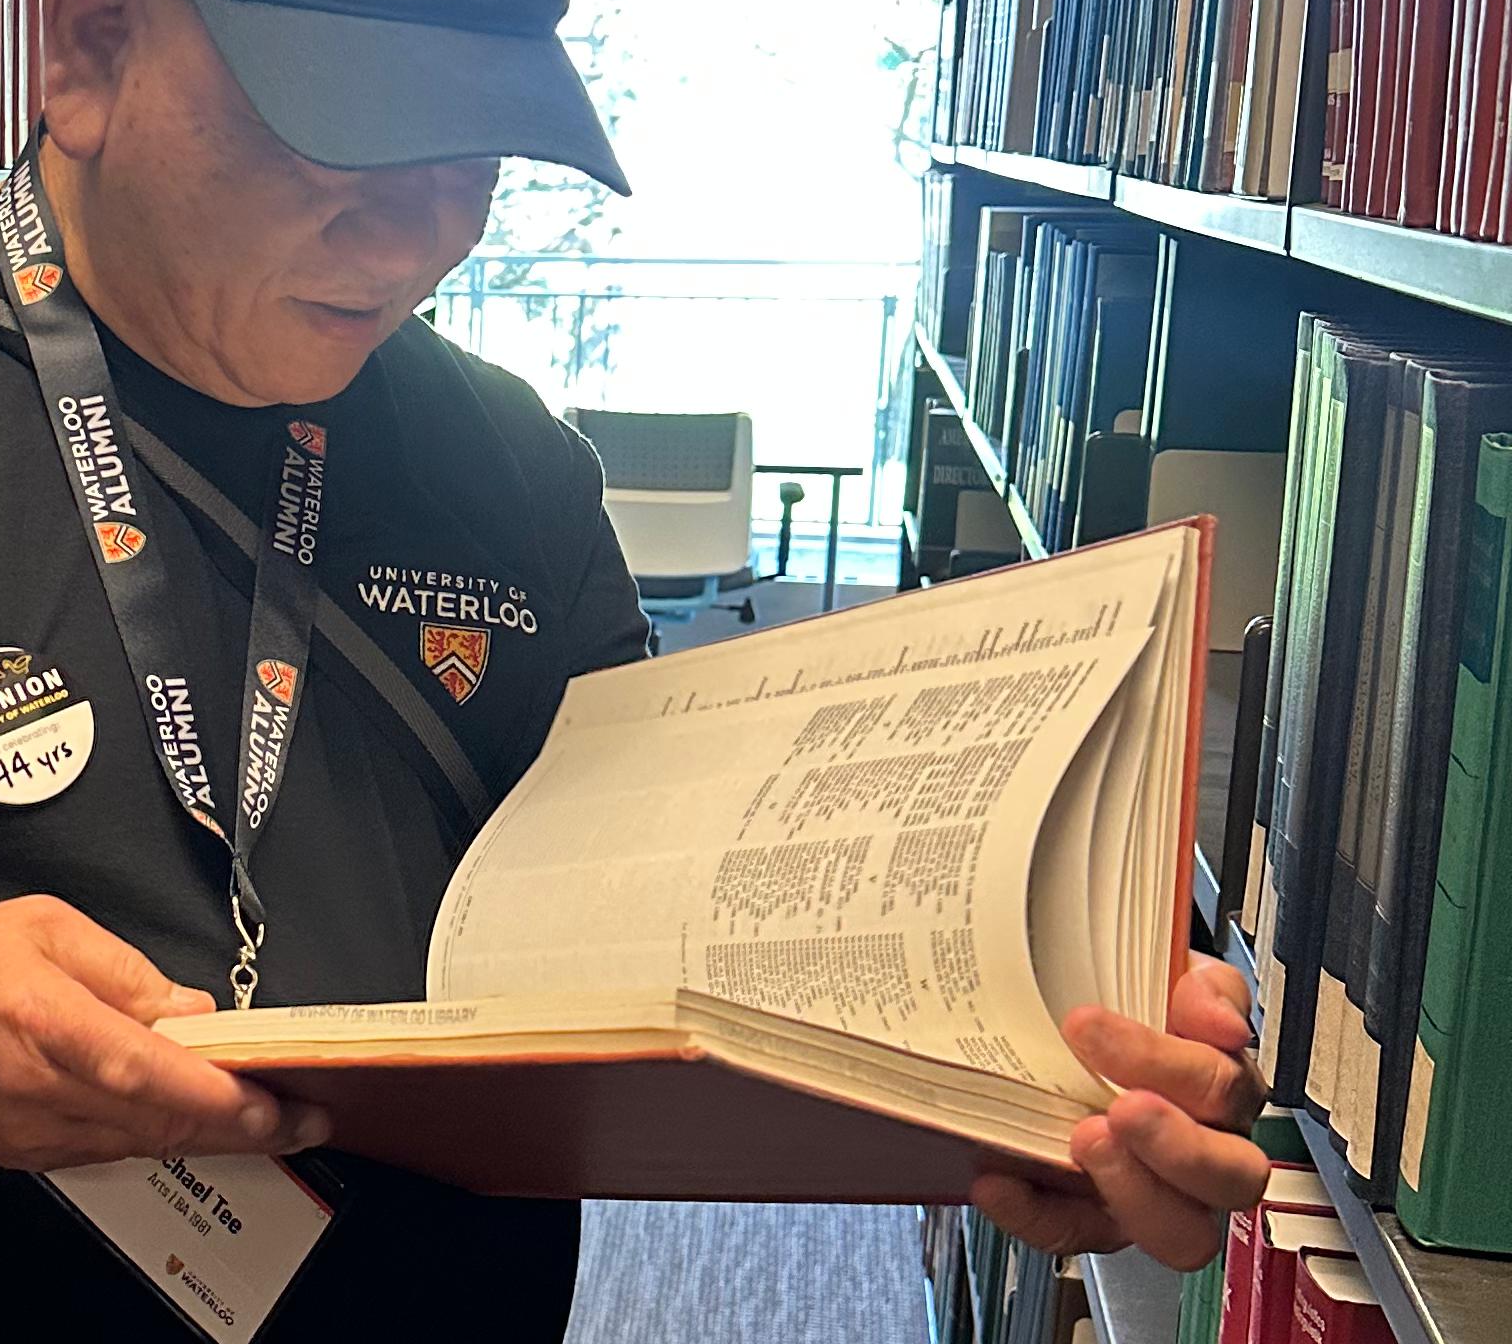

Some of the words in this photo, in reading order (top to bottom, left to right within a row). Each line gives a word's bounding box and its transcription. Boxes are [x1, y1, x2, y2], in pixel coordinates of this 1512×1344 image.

[14, 159, 53, 257] ALUMNI
[58, 396, 101, 522] WATERLOO
[79, 394, 138, 517] ALUMNI
[272, 446, 306, 556] ALUMNI
[296, 457, 325, 566] WATERLOO
[357, 582, 538, 635] WATERLOO
[369, 565, 501, 594] UNIVERSITY
[508, 586, 528, 604] OF
[5, 707, 20, 721] OF
[19, 689, 70, 715] WATERLOO
[145, 673, 198, 807] WATERLOO
[164, 676, 216, 810] ALUMNI
[240, 689, 273, 817] ALUMNI
[37, 741, 74, 775] yrs
[248, 704, 291, 831] WATERLOO
[427, 1006, 479, 1025] LIBRARY
[147, 1171, 171, 1198] Arts
[188, 1210, 212, 1237] 1981
[211, 1193, 242, 1235] Tee
[181, 1270, 236, 1327] WATERLOO
